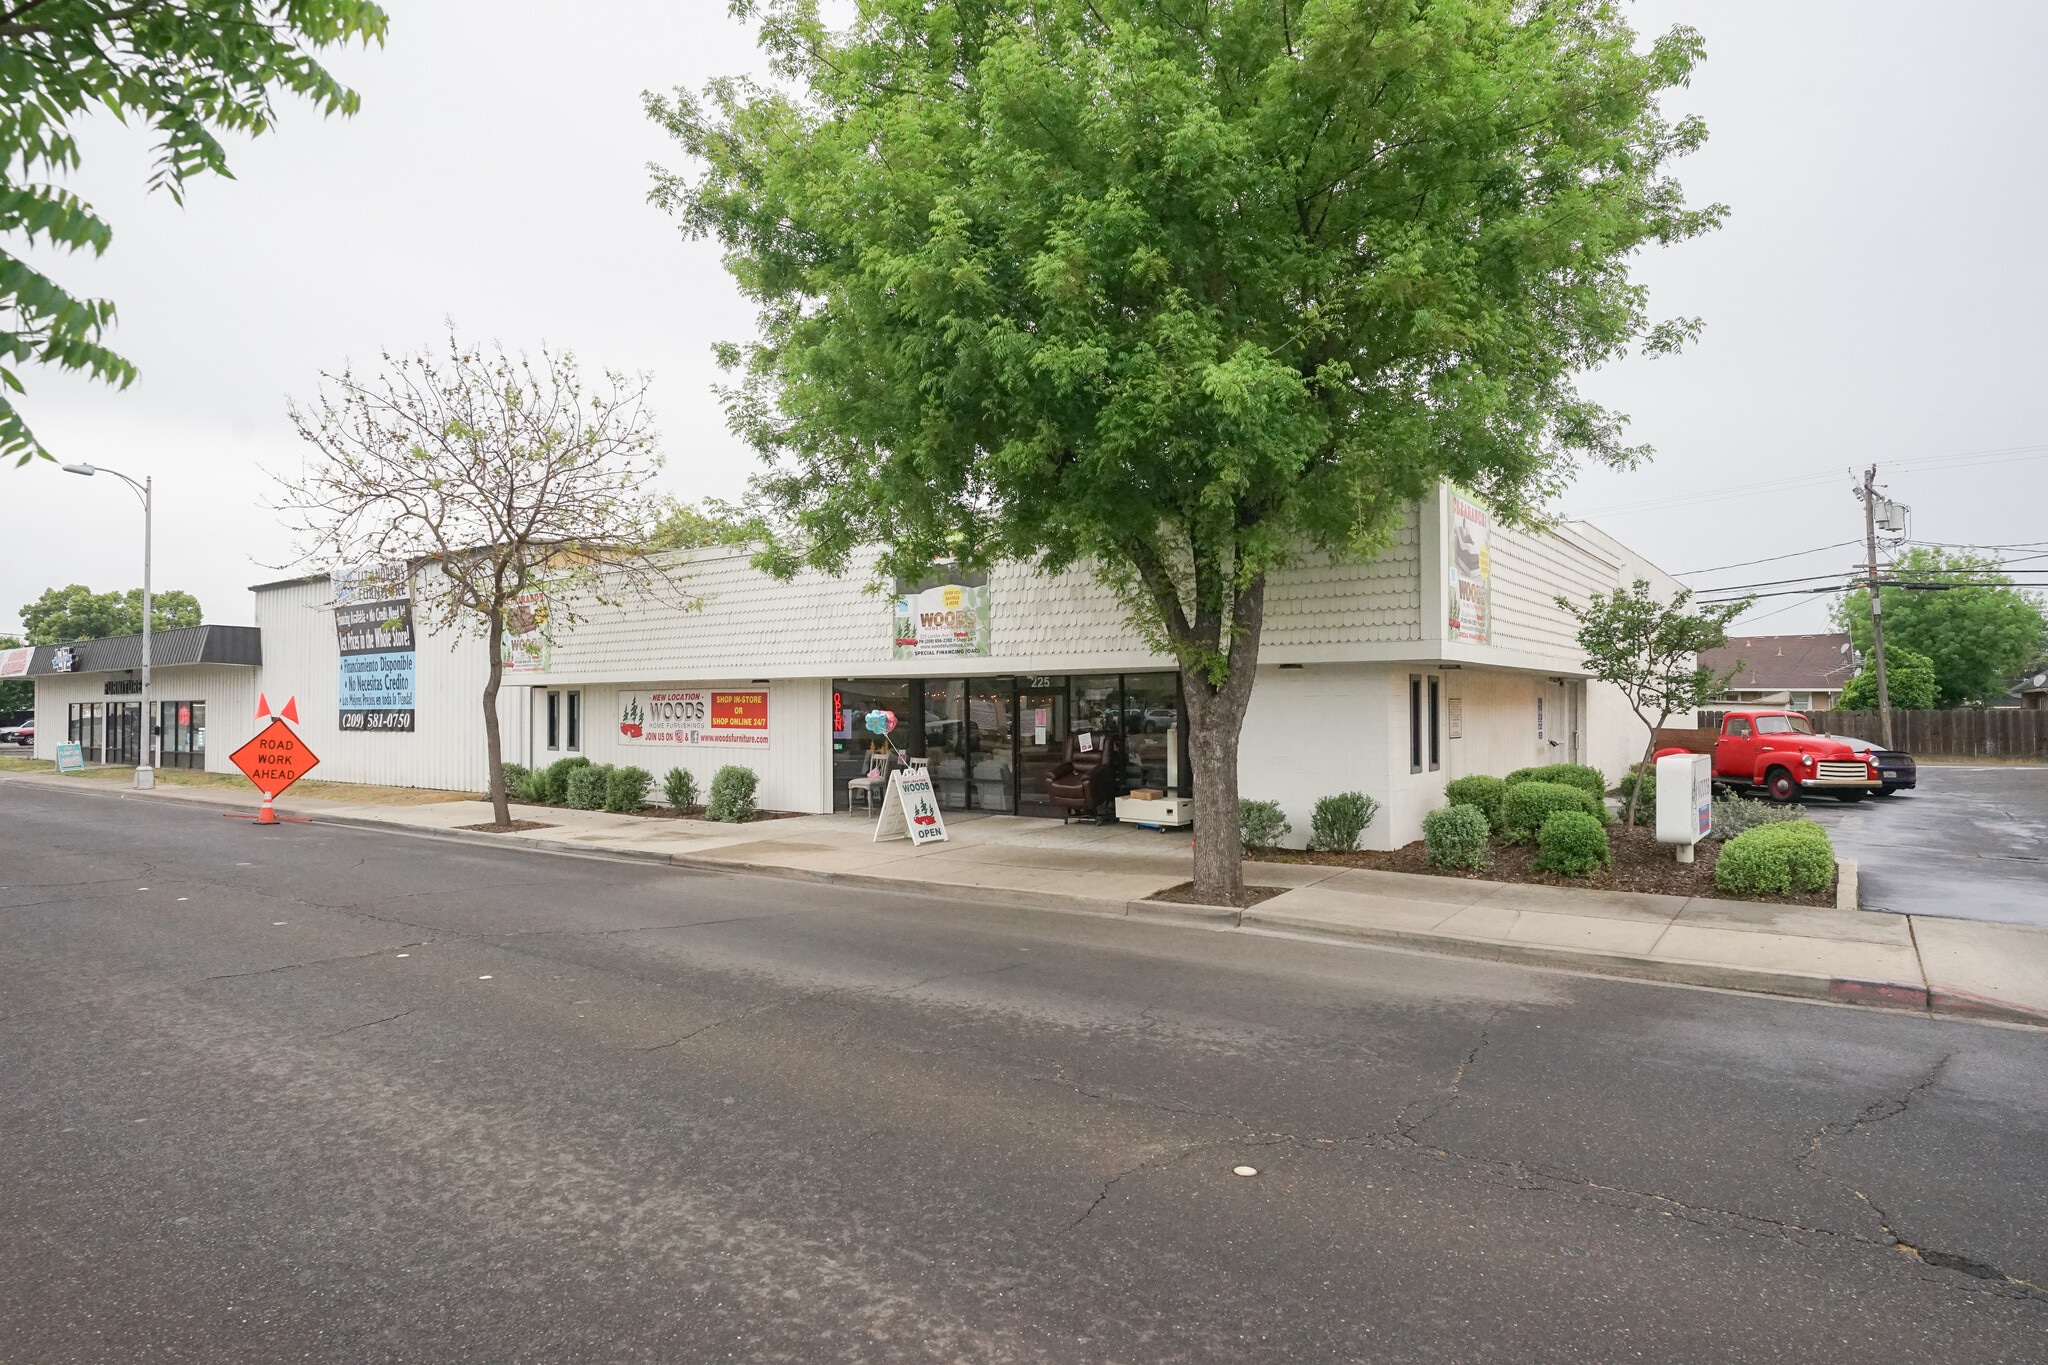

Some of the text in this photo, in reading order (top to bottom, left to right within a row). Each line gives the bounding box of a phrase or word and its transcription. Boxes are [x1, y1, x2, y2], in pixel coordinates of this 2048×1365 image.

[920, 610, 976, 627] WOODS
[374, 628, 391, 648] Whole
[392, 625, 410, 647] Store!
[344, 655, 412, 673] Financiamiento Disponible
[348, 674, 408, 691] No Necesitas Credito
[1031, 677, 1050, 687] 225
[650, 702, 704, 721] WOODS
[834, 692, 843, 731] OPEN
[342, 713, 410, 728] (209) 581-0750
[645, 732, 656, 741] JOIN
[700, 734, 768, 743] www.woodsfurniture.com
[260, 739, 293, 750] ROAD
[258, 755, 292, 765] WORK
[252, 769, 294, 779] AHEAD
[902, 782, 930, 792] WOODS
[918, 828, 942, 838] OPEN
